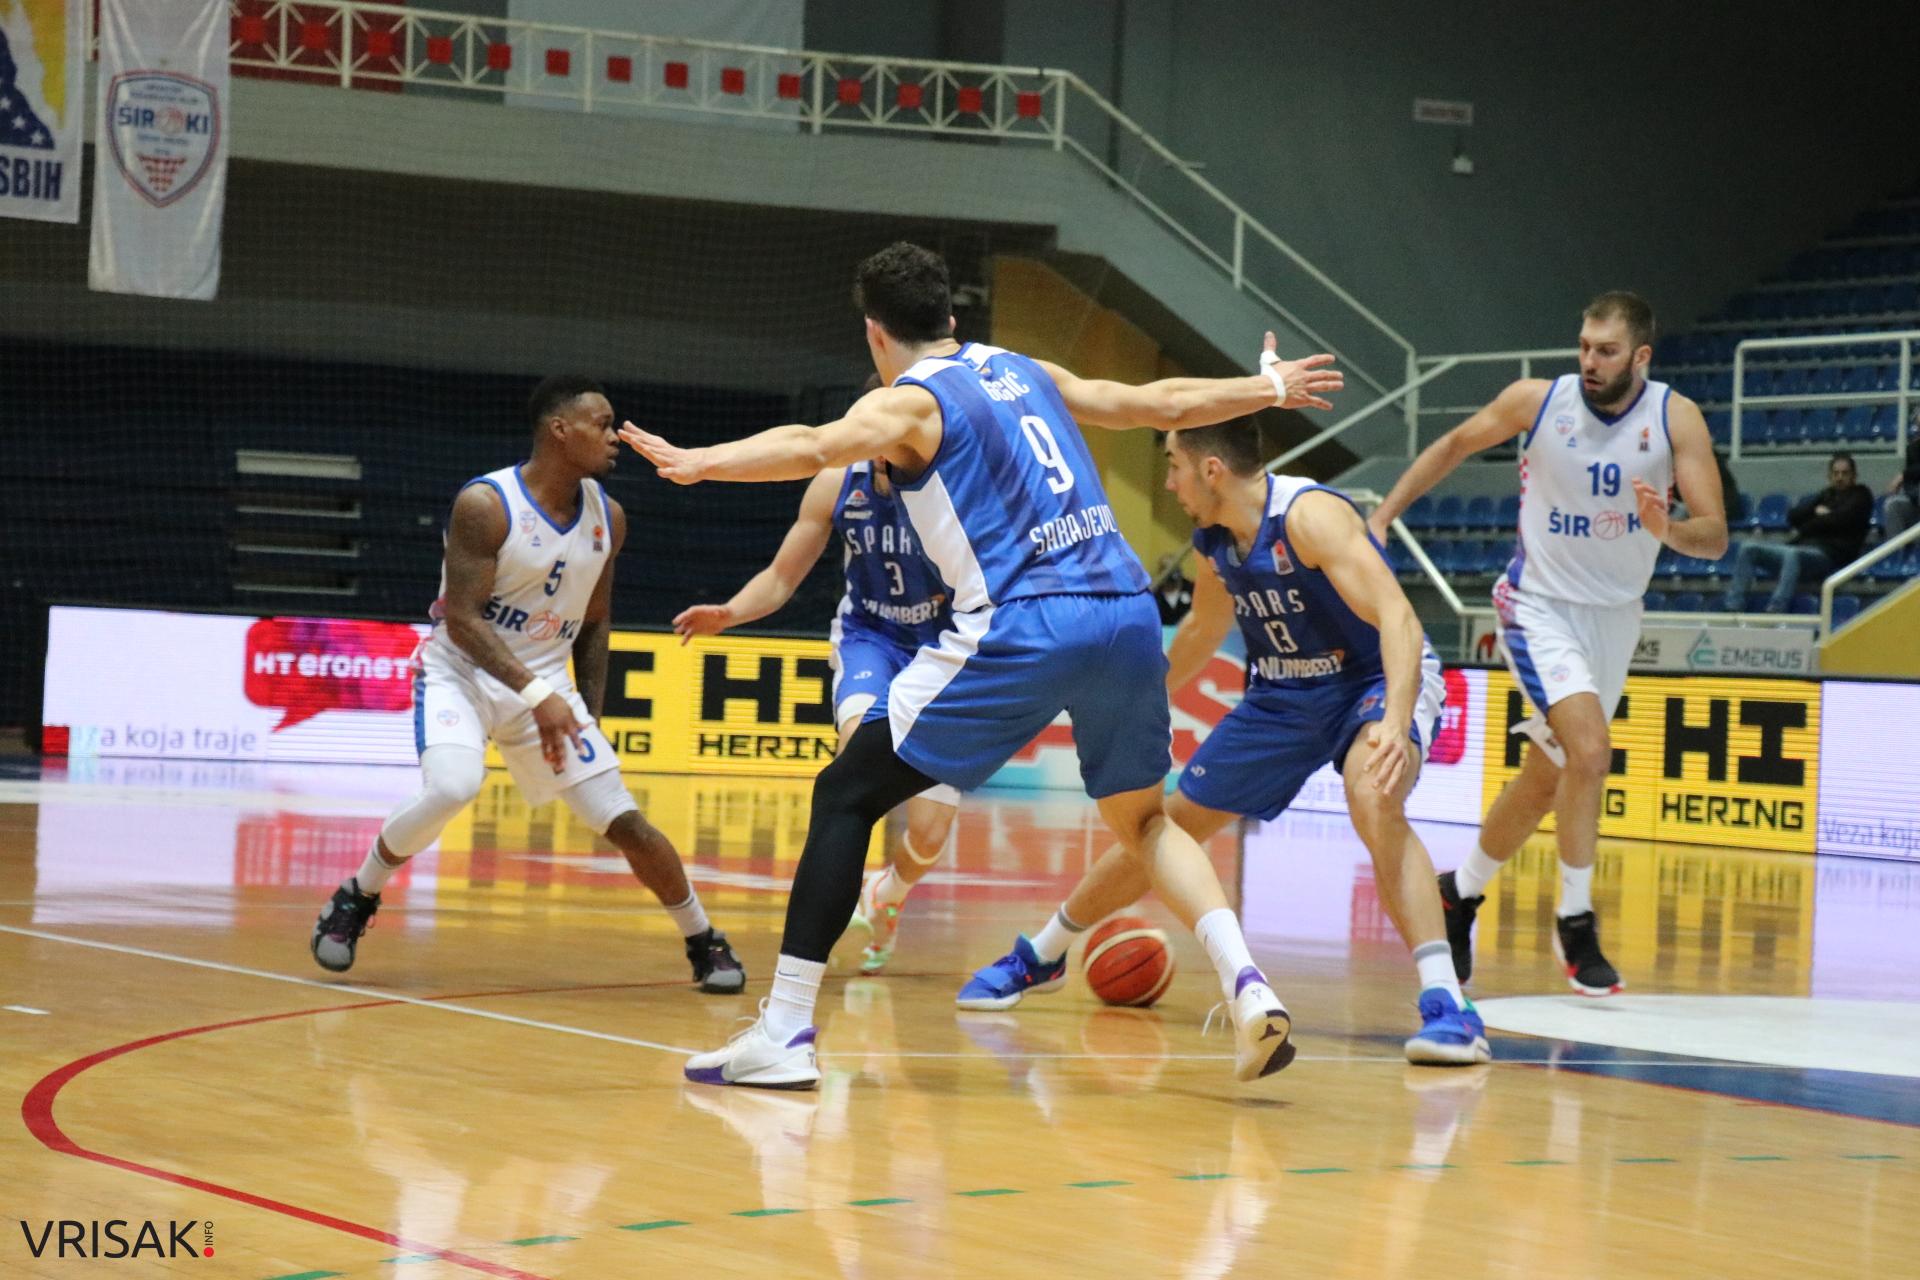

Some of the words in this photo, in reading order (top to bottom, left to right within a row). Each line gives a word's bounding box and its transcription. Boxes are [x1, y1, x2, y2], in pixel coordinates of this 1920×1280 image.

[1020, 415, 1074, 494] 9
[1587, 461, 1621, 497] 19
[846, 525, 914, 556] SPAR
[544, 560, 566, 597] 5
[884, 561, 905, 596] 3
[1235, 588, 1305, 619] PARS
[1264, 620, 1299, 653] 13
[1720, 647, 1803, 669] EMERUS
[126, 724, 184, 754] koja
[194, 728, 257, 755] traje
[699, 733, 839, 760] HERIN
[1663, 697, 1807, 786] HI
[1661, 793, 1804, 830] HERING
